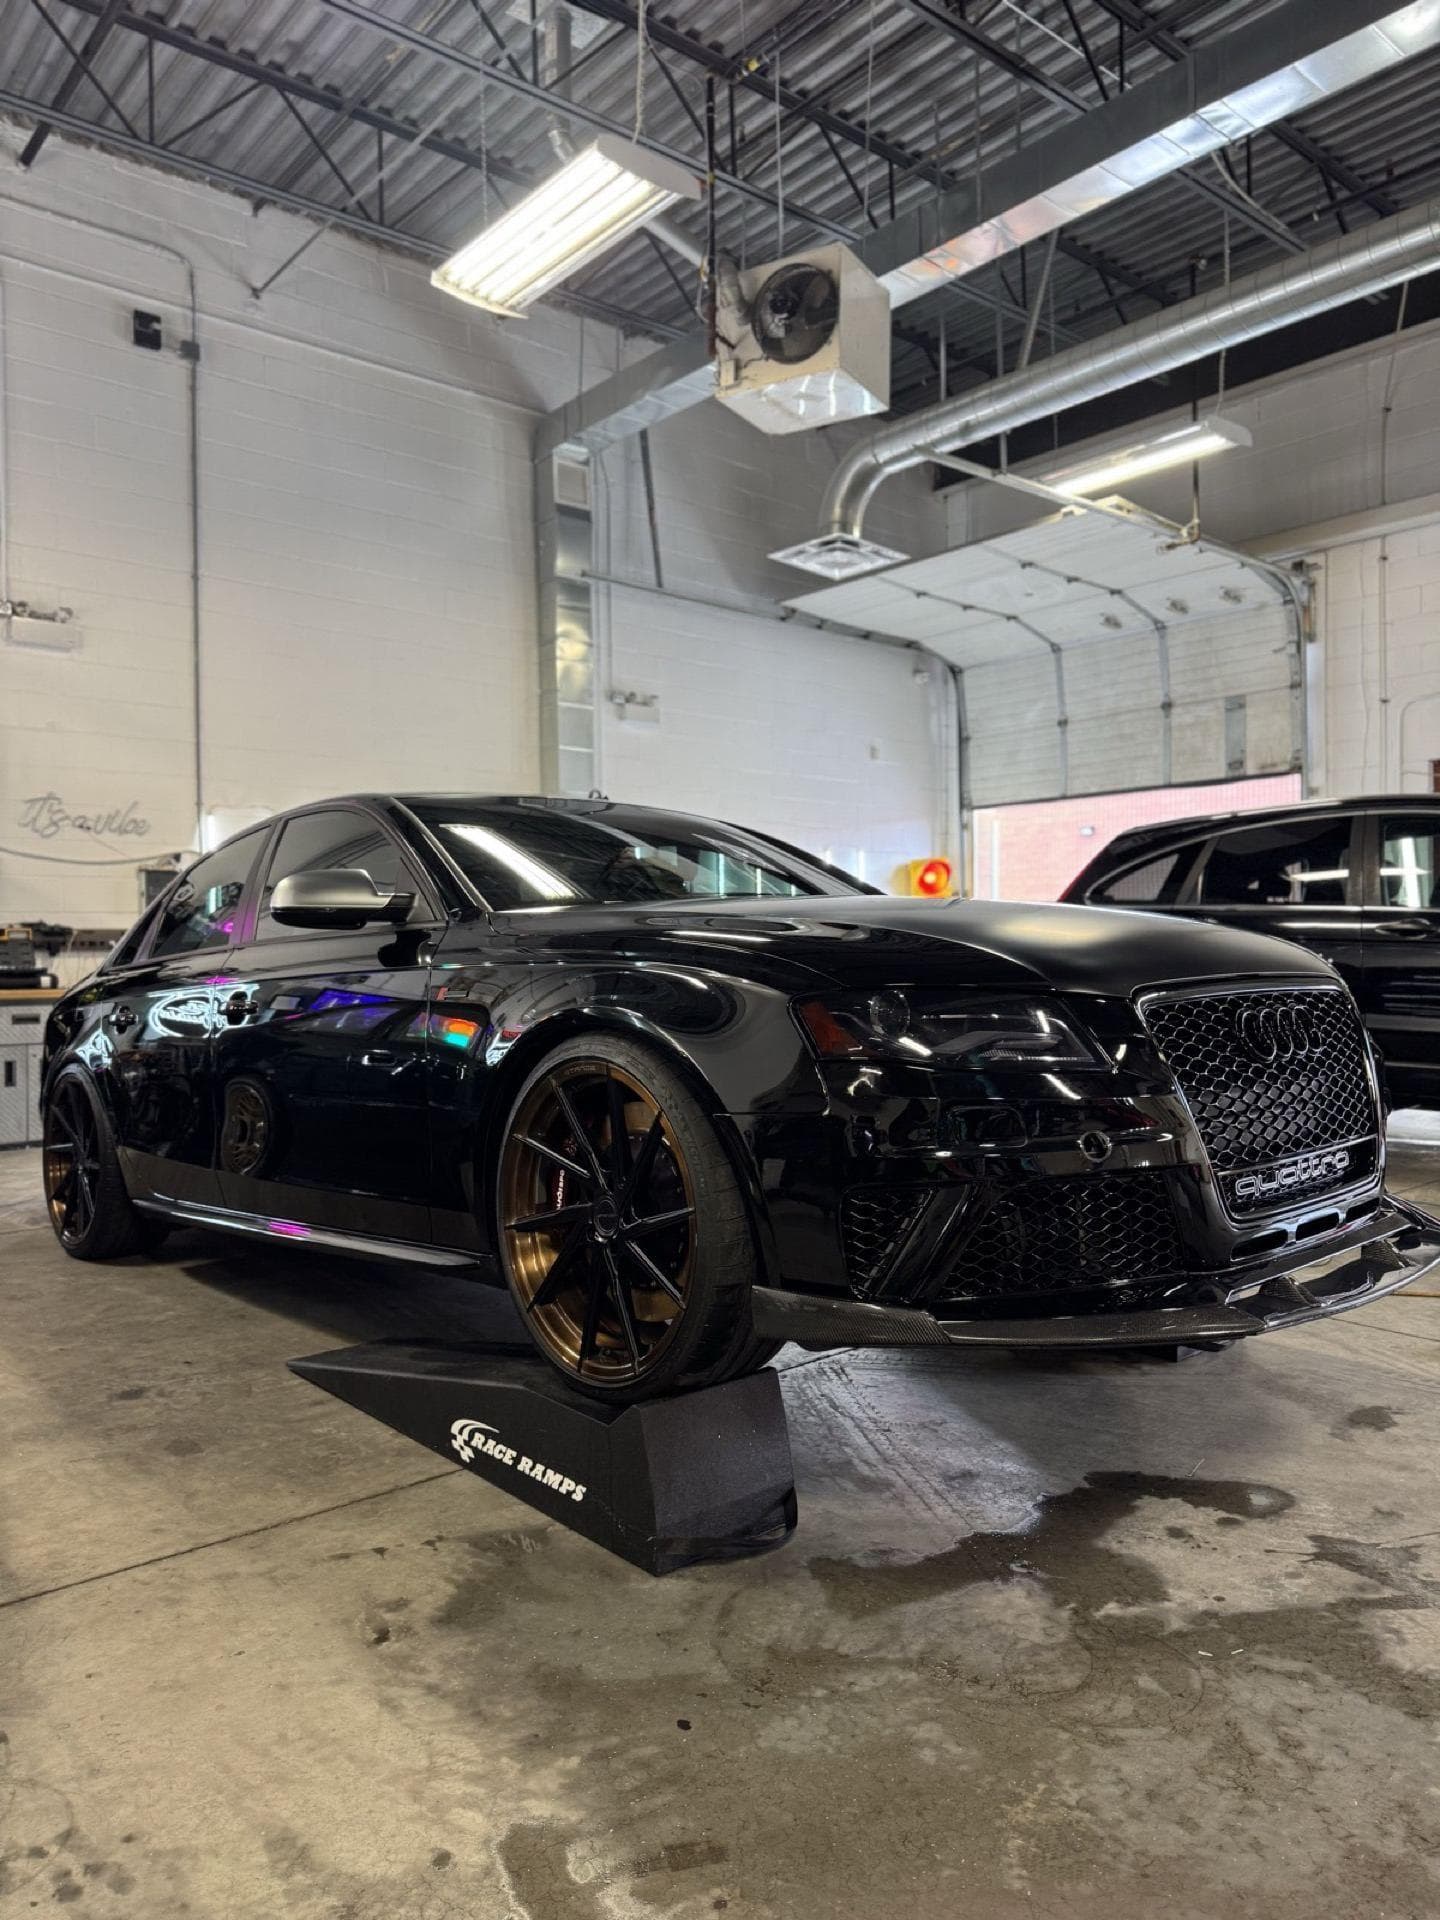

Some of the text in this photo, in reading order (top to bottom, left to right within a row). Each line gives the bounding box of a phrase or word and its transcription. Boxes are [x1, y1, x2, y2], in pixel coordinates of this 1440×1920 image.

[1235, 1150, 1350, 1196] quattro
[470, 1432, 587, 1501] RACE RAMPS
